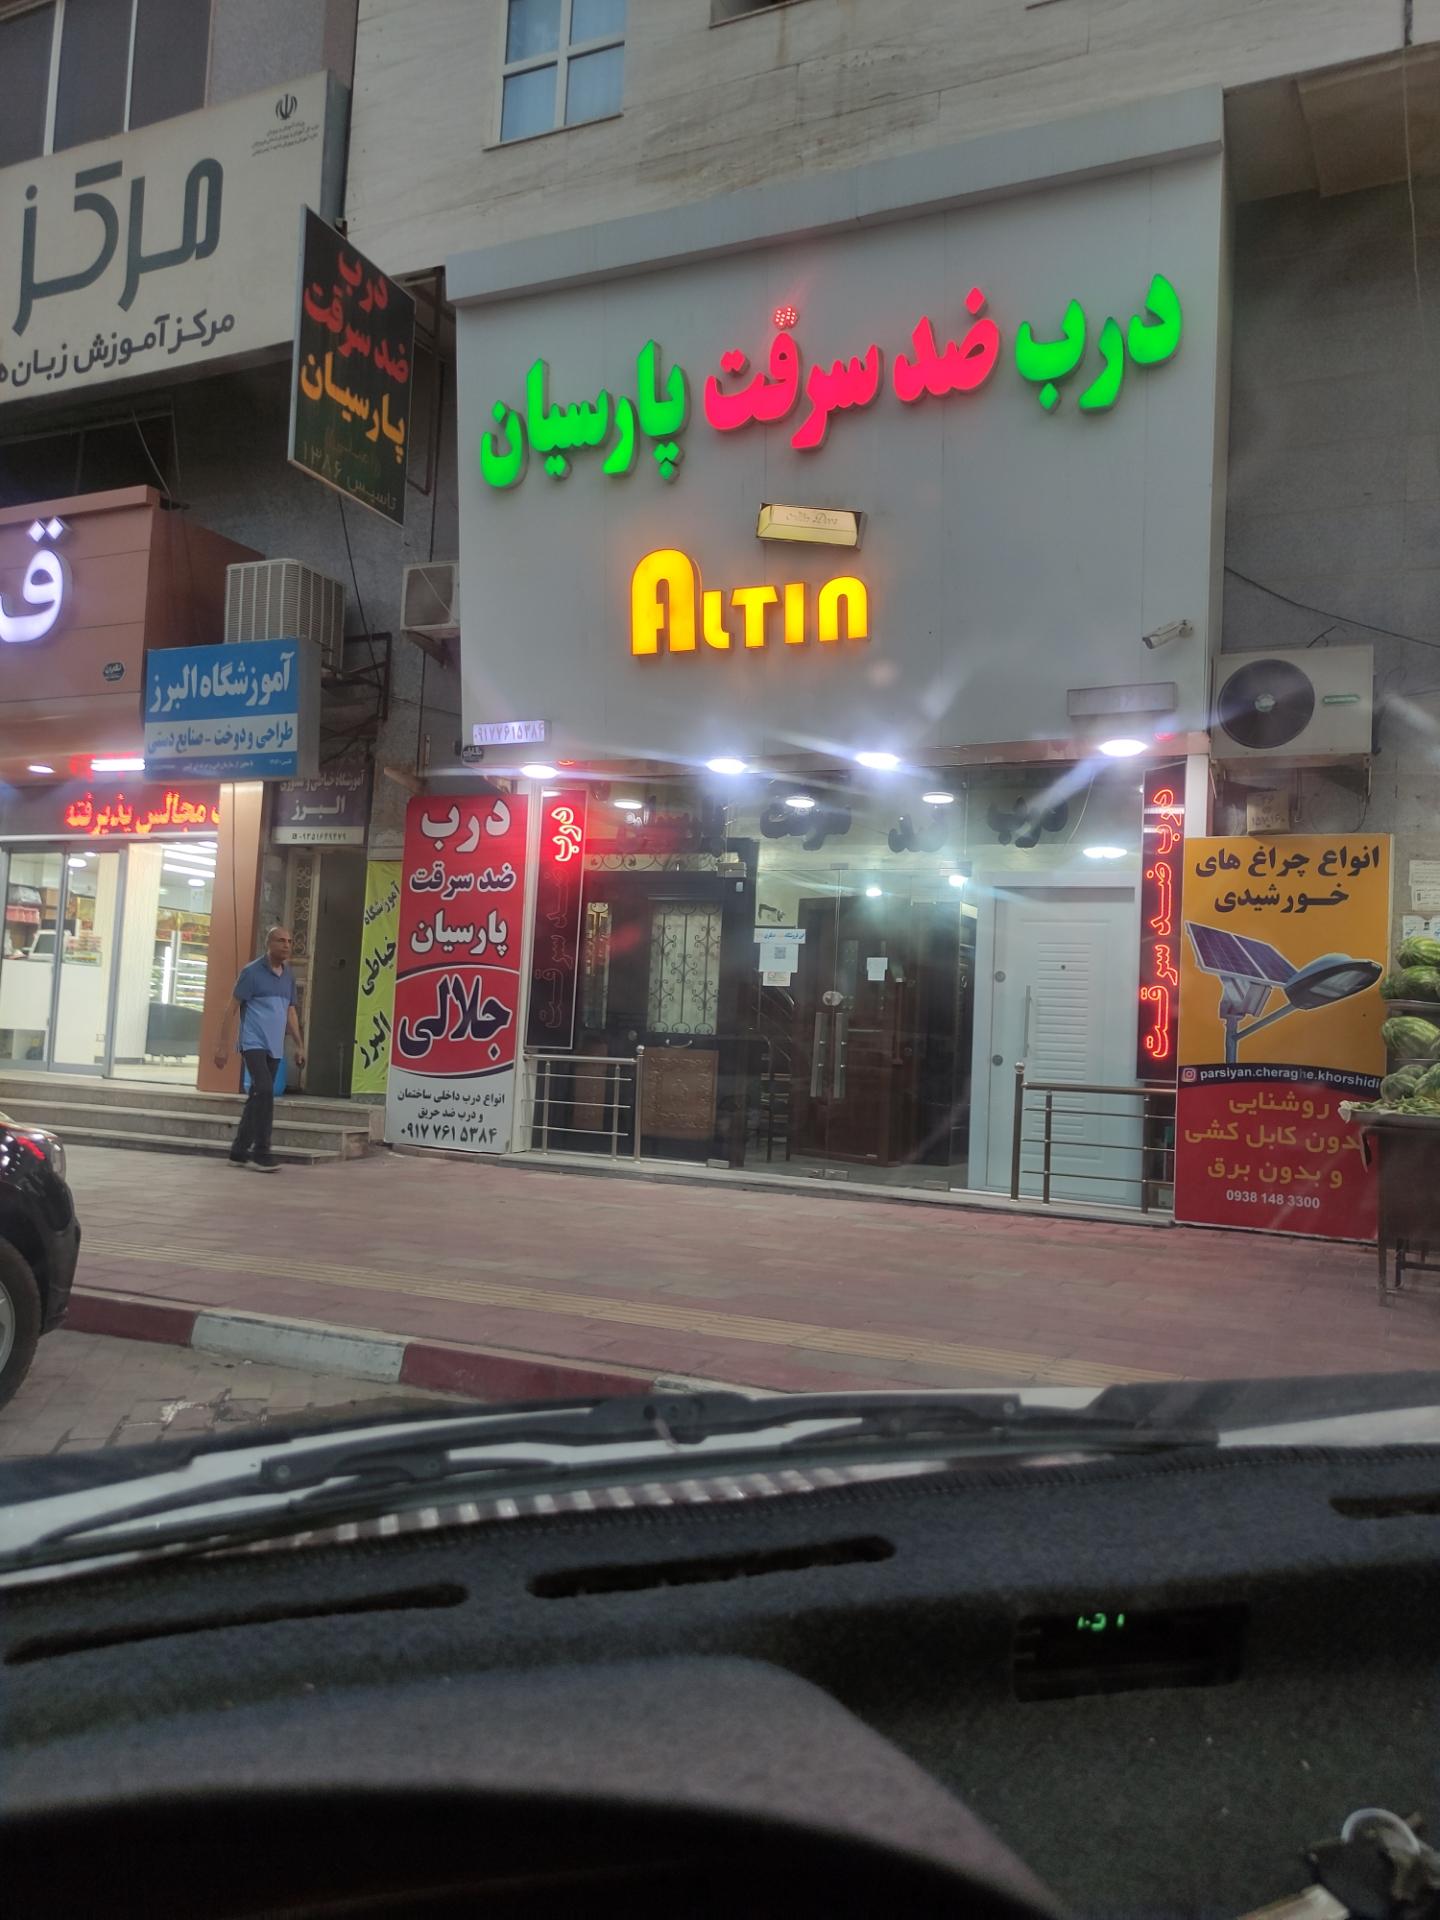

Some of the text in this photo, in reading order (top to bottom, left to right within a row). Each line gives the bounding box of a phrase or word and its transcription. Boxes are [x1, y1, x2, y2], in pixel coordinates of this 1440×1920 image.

[12, 157, 223, 336] مرکز
[338, 250, 389, 312] درب
[74, 313, 170, 374] آموزش
[168, 309, 235, 354] مرکز
[304, 282, 409, 384] ضد سرقت
[12, 343, 68, 387] زبان
[480, 273, 1182, 488] درب ضد سرقت پارسیان
[301, 351, 406, 464] پارسیان
[149, 651, 296, 713] آموزشگاه البرز
[175, 727, 203, 754] صنایع
[214, 723, 246, 750] دوخت
[256, 720, 293, 749] طراحی
[65, 792, 133, 835] پذیرفته
[135, 791, 207, 834] مجالس
[290, 794, 346, 821] البرز
[421, 800, 511, 852] درب
[551, 806, 582, 862] درب
[410, 860, 516, 900] ضد سرقت
[1195, 845, 1380, 877] انواع چراغ های
[364, 880, 401, 926] آموزشگاه
[1214, 882, 1350, 913] خورشیدی
[411, 909, 508, 956] پارسیان
[1141, 789, 1182, 1058] درب ضد سرقت
[361, 936, 397, 996] خیاطی
[399, 974, 513, 1060] جلالی
[397, 1088, 505, 1106] انواع درب داخلی ساختمان
[1200, 1066, 1380, 1089] parsiyan.cheraghe.khorshidi
[418, 1107, 440, 1119] حریق
[442, 1107, 455, 1118] ضد
[458, 1110, 476, 1122] درب
[1228, 1090, 1330, 1119] روشنایی
[400, 1122, 498, 1144] ۰۹۱۷ ۷۶۱ ۵۳۸۴
[1184, 1119, 1361, 1154] دون کابل کشی
[1207, 1157, 1343, 1189] و بدون برق
[1226, 1189, 1321, 1209] 0938 148 3300
